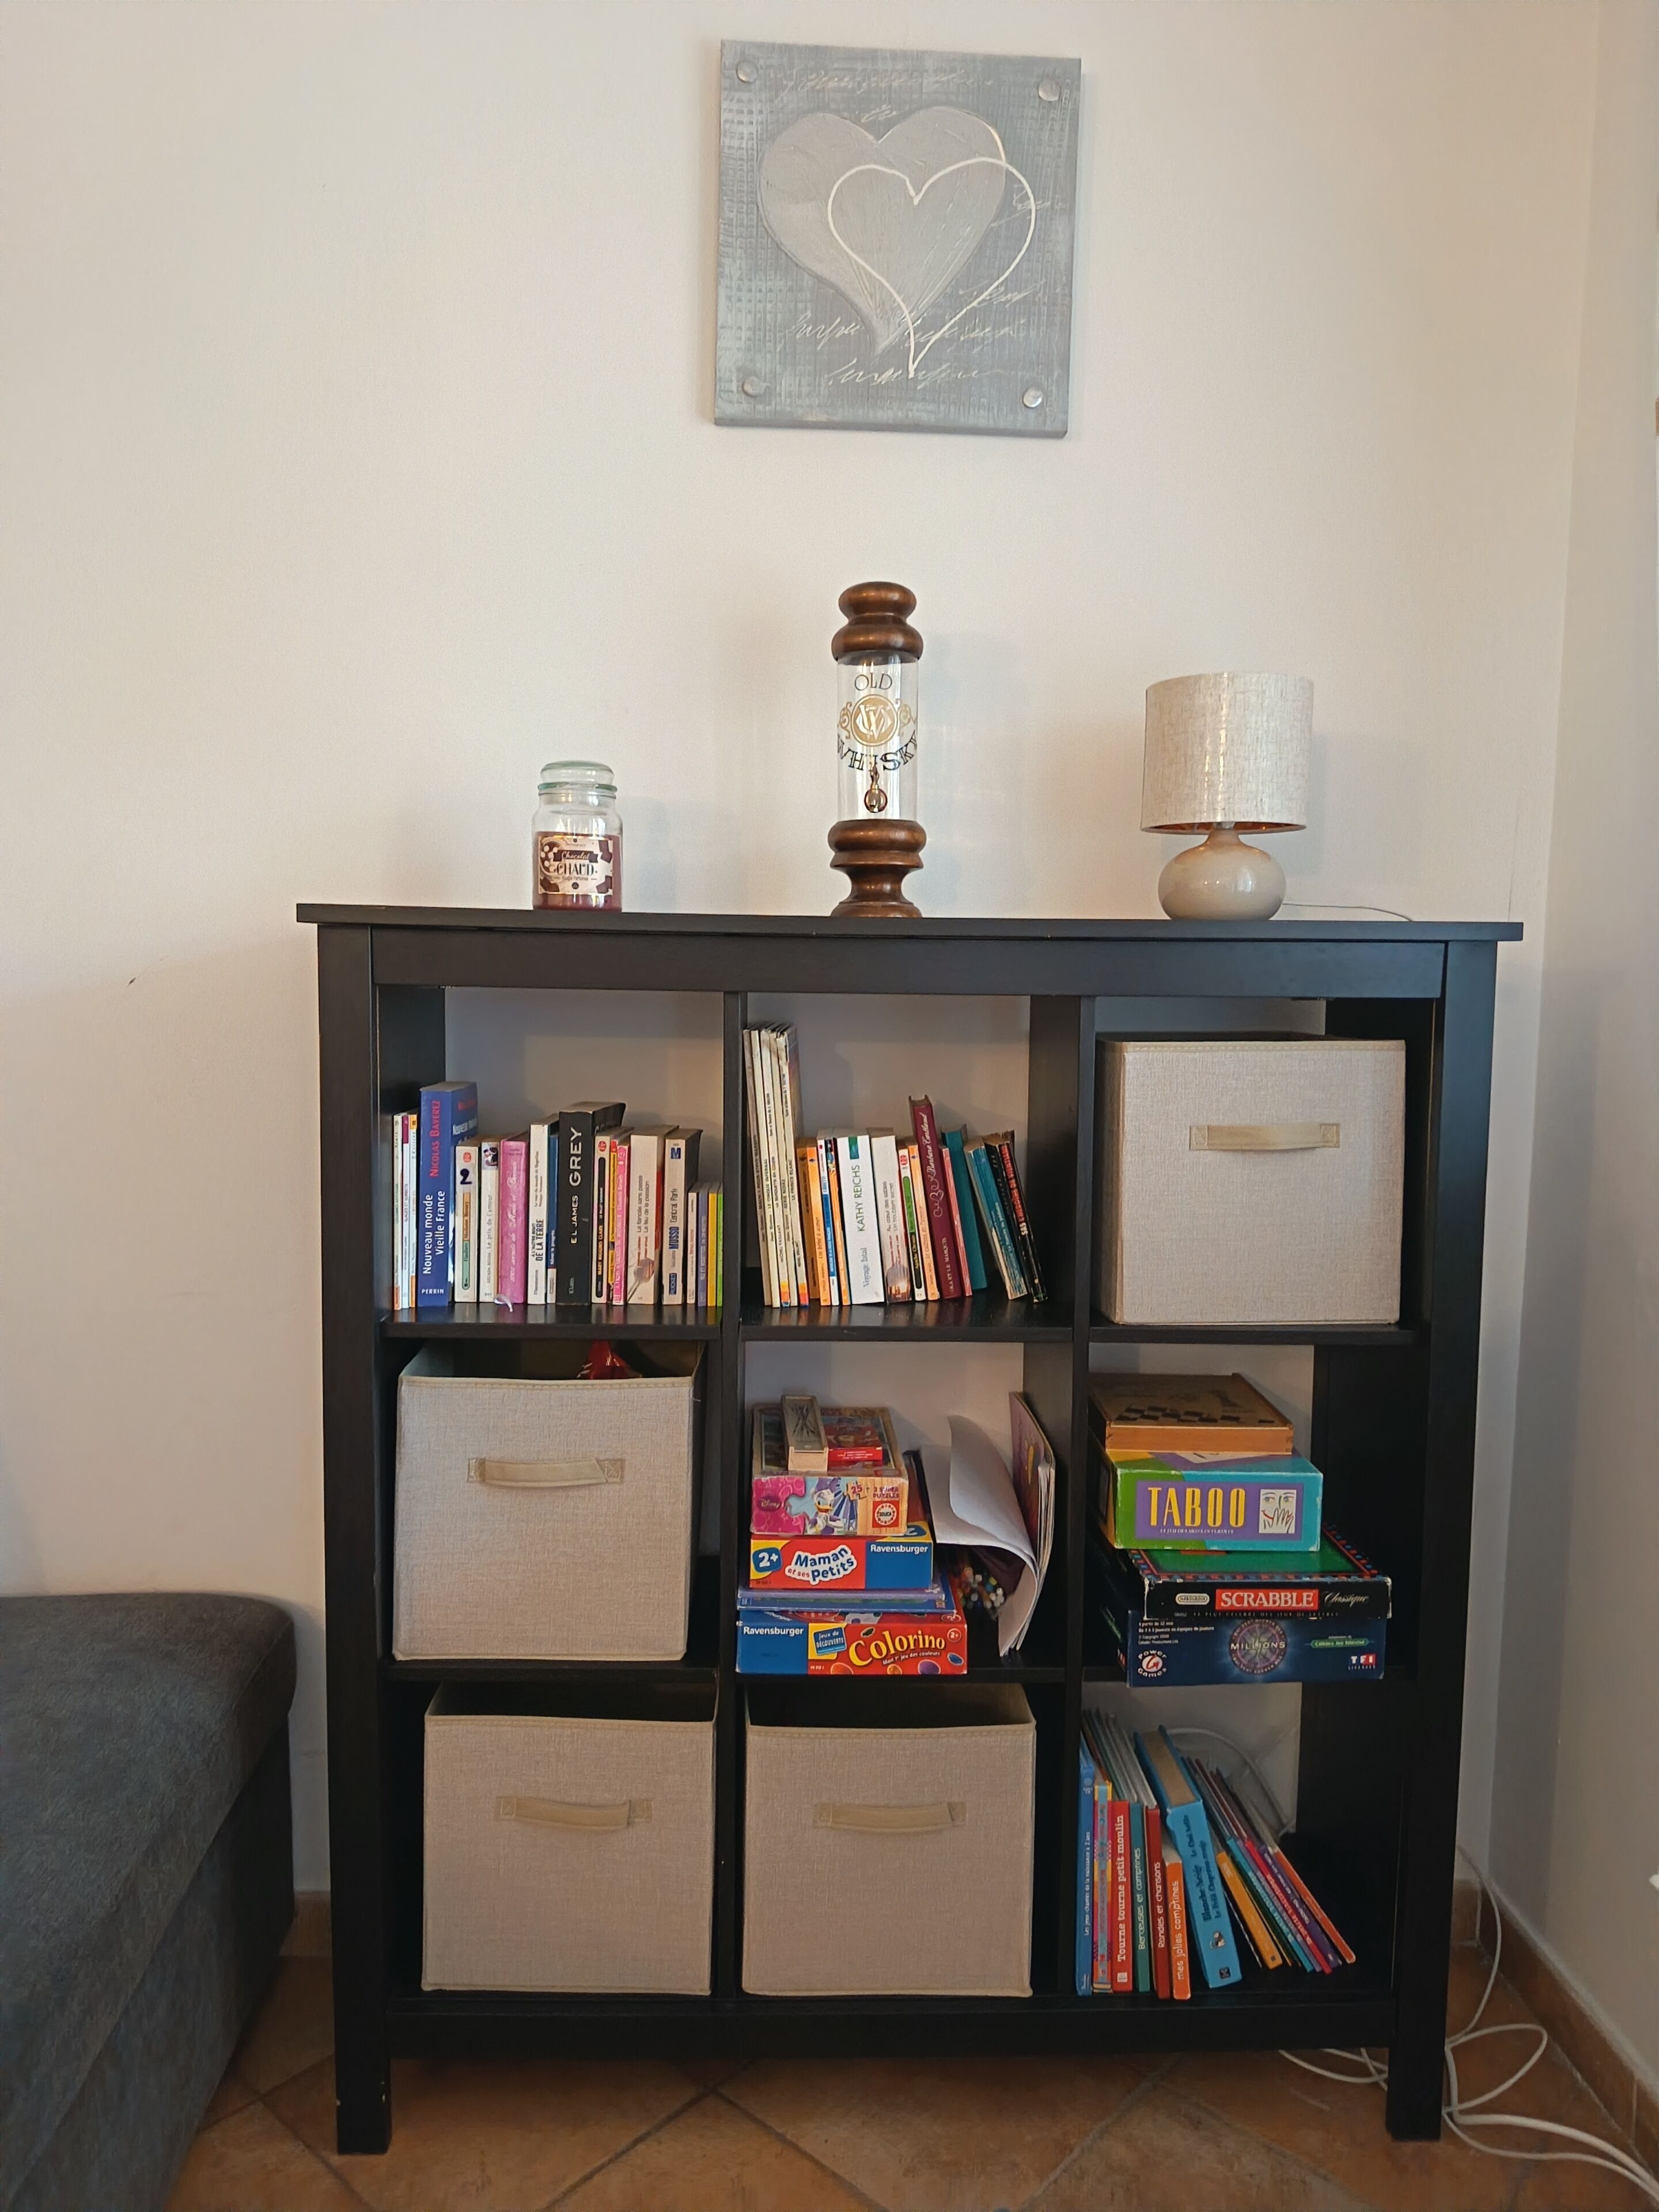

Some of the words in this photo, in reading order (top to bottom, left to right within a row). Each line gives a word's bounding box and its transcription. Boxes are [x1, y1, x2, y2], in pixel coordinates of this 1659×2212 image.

[854, 673, 892, 691] OLD
[837, 730, 918, 771] WHISKY
[561, 851, 590, 859] Chocolat
[556, 862, 594, 876] CHAUD
[430, 1100, 440, 1137] BAVEREZ
[429, 1139, 439, 1176] NICOLAS
[569, 1127, 582, 1187] GREY
[926, 1145, 936, 1172] Barbara
[851, 1164, 863, 1199] REICHS
[423, 1195, 433, 1228] monde
[436, 1191, 445, 1222] France
[669, 1203, 677, 1222] Central
[855, 1202, 865, 1232] KATHY
[435, 1226, 444, 1255] Vieille
[536, 1219, 544, 1240] TERRE
[669, 1226, 679, 1249] MUSSO
[1018, 1222, 1029, 1236] SAS
[423, 1232, 432, 1274] Nouveau
[536, 1242, 544, 1250] LA
[536, 1252, 544, 1260] DE
[859, 1247, 869, 1262] fatal
[862, 1264, 871, 1288] Voyage
[851, 1485, 862, 1496] 25
[760, 1497, 781, 1509] Disney
[1147, 1487, 1246, 1527] TABOO
[757, 1552, 779, 1568] 2+
[794, 1548, 849, 1567] Maman
[870, 1544, 928, 1554] Ravensburger
[1221, 1592, 1314, 1607] SCRABBLE
[1323, 1591, 1369, 1608] Classique
[743, 1626, 804, 1636] Ravensburger
[849, 1630, 945, 1666] Colorino
[1230, 1641, 1286, 1650] MILLIONS
[1350, 1655, 1374, 1664] TF1
[1114, 1814, 1124, 1854] moulin
[1116, 1856, 1127, 1881] petit
[1134, 1847, 1143, 1891] comptines
[1153, 1862, 1162, 1902] chansons
[1116, 1884, 1126, 1921] tourne
[1136, 1893, 1143, 1903] et
[1157, 1904, 1164, 1914] et
[1169, 1880, 1182, 1930] comptines
[1199, 1886, 1211, 1921] Blanche
[1137, 1904, 1146, 1950] Berceuses
[1157, 1916, 1166, 1948] Rondes
[1118, 1923, 1126, 1962] Tourne
[1173, 1933, 1185, 1957] jolies
[1176, 1960, 1184, 1980] mes
